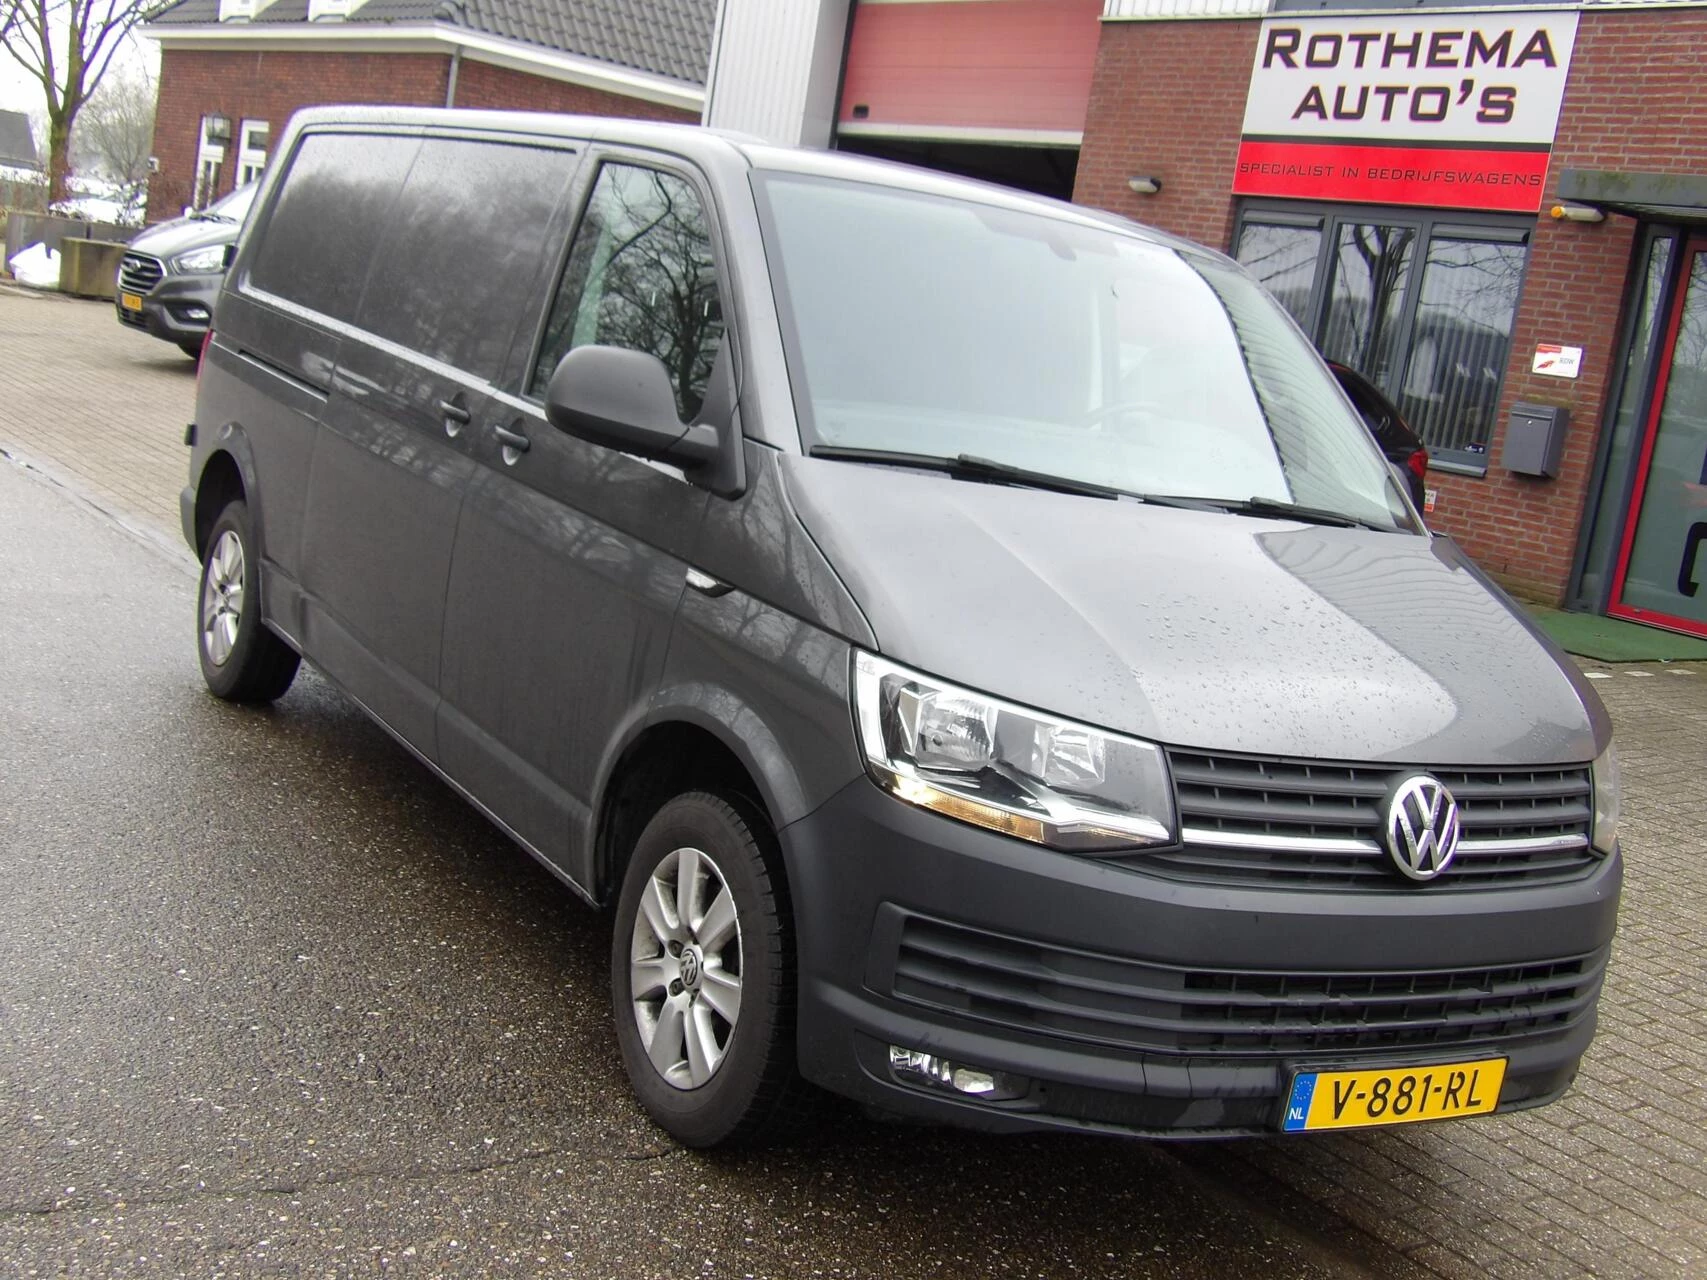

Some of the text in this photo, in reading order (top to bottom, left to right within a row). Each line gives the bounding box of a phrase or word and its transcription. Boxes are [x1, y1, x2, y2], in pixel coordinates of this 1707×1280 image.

[1262, 27, 1558, 69] ROTHEMA
[1291, 78, 1518, 124] AUTO'S
[1239, 162, 1542, 187] SPECIALIST IN BEDRIJFSWAGENS
[1288, 1106, 1305, 1120] NL
[1332, 1068, 1482, 1121] V-881-RL
